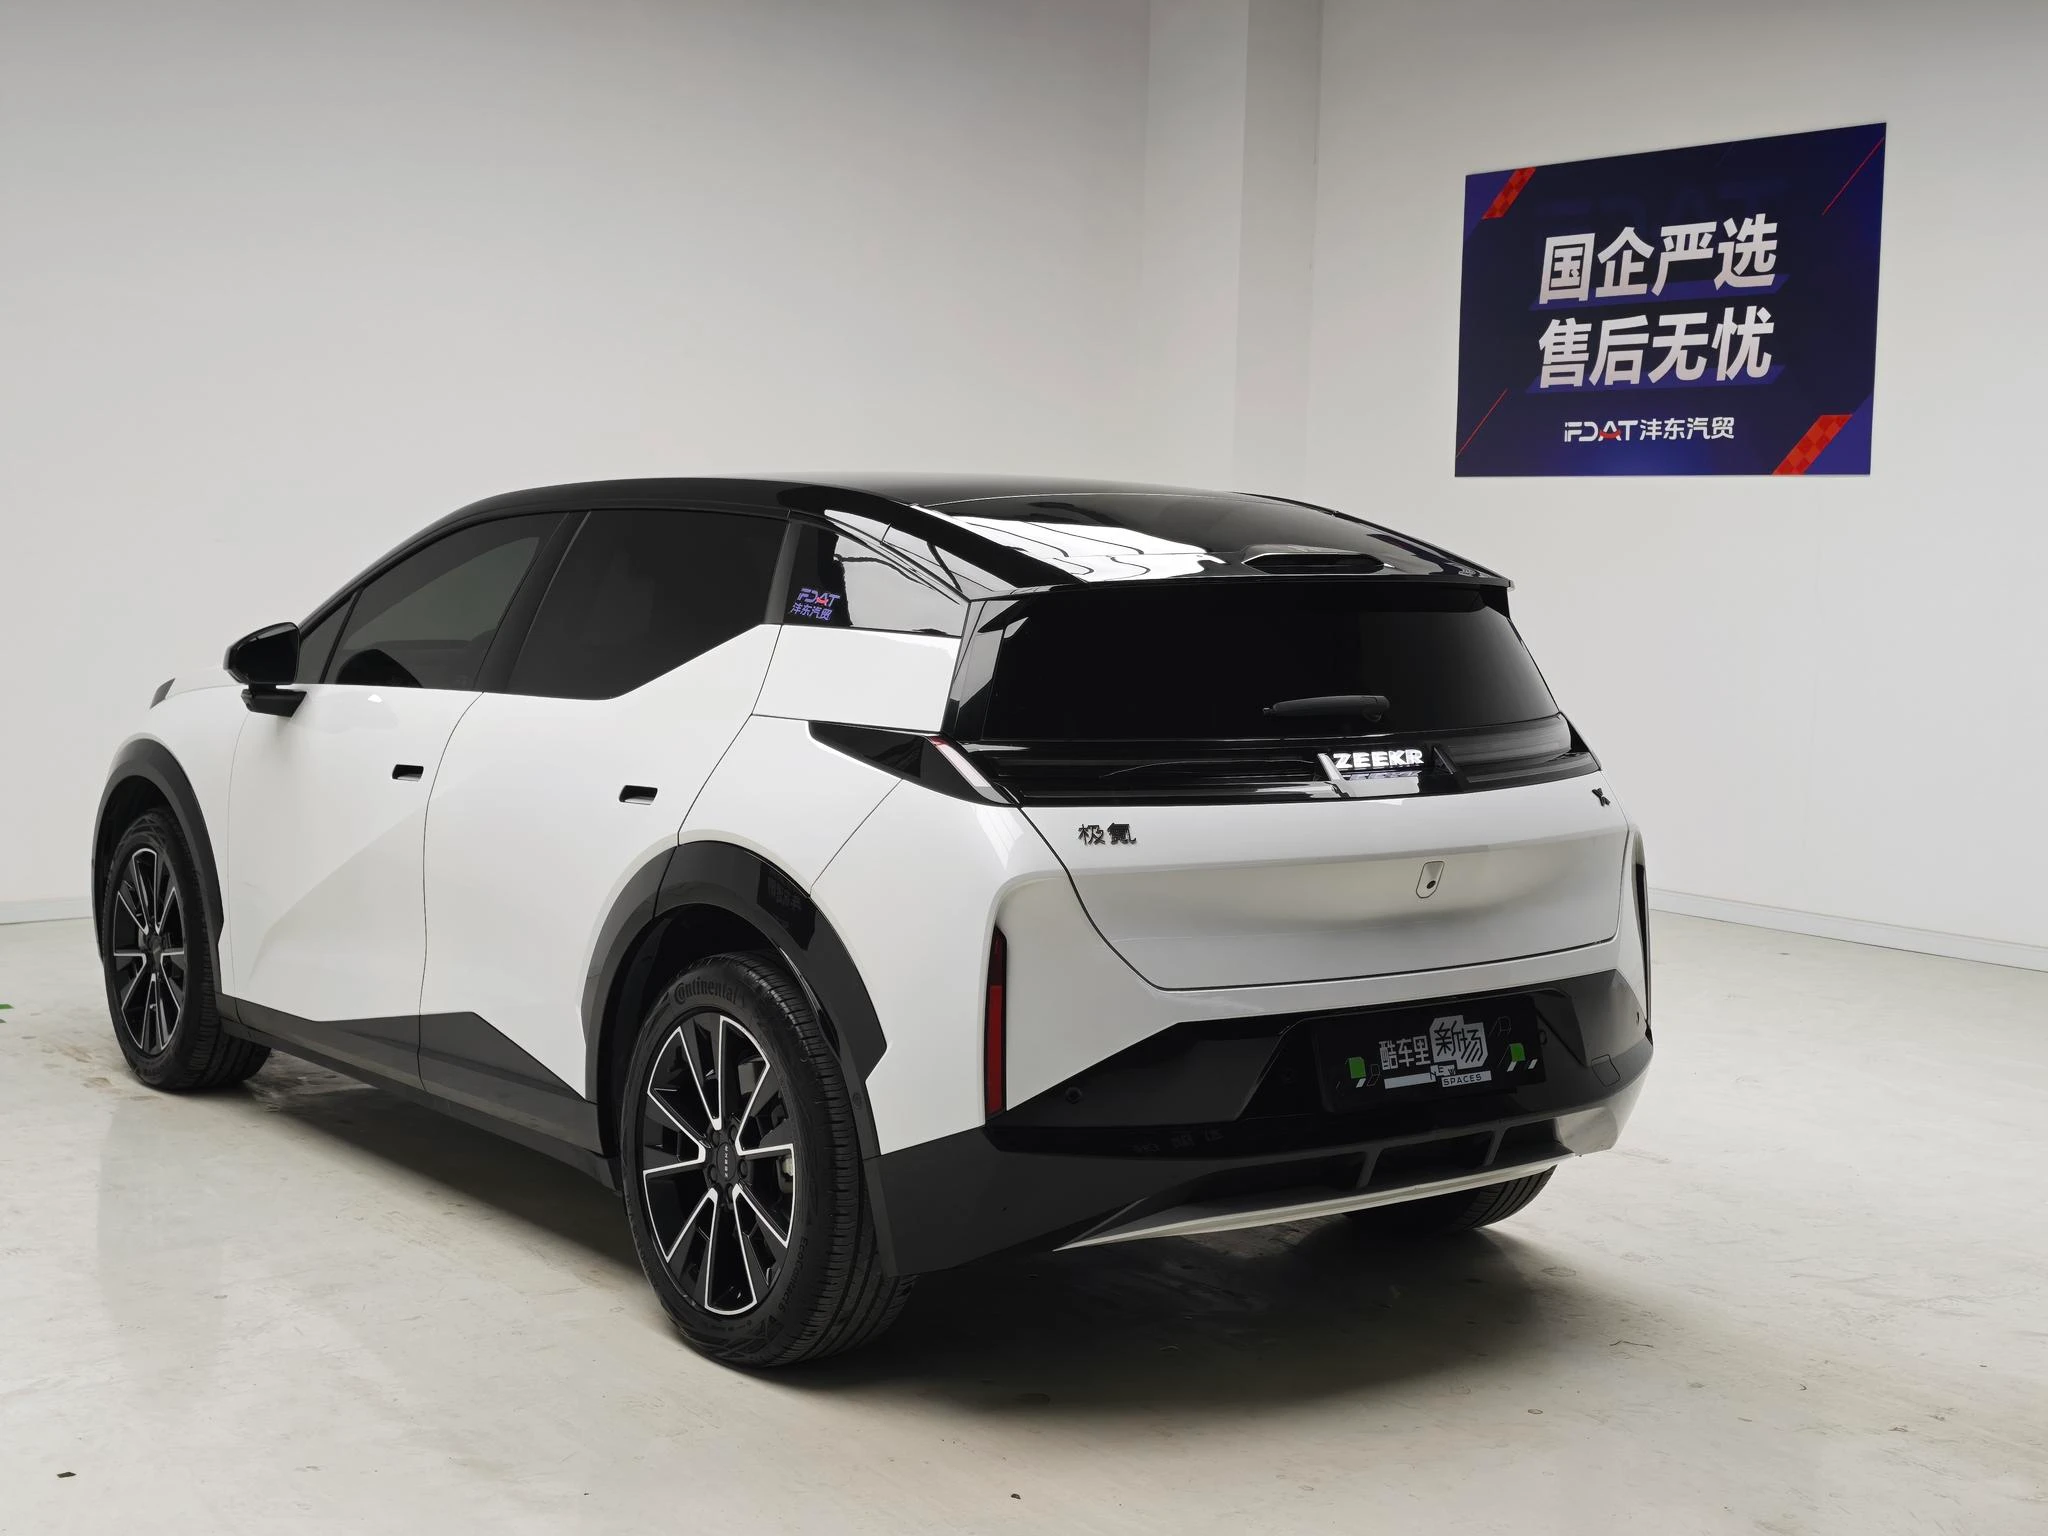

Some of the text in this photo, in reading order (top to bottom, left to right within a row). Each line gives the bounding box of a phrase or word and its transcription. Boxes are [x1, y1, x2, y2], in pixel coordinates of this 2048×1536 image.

[1538, 213, 1778, 305] 国企严选
[1538, 305, 1775, 389] 售后无忧
[1639, 416, 1735, 441] 沣东汽贸
[790, 602, 832, 620] 沣东汽贸
[1333, 749, 1424, 769] ZEEKR
[1078, 822, 1137, 846] 极氪
[674, 976, 738, 1005] Continental
[1378, 1019, 1485, 1071] 酷车里 新场
[1443, 1073, 1482, 1087] SPACES
